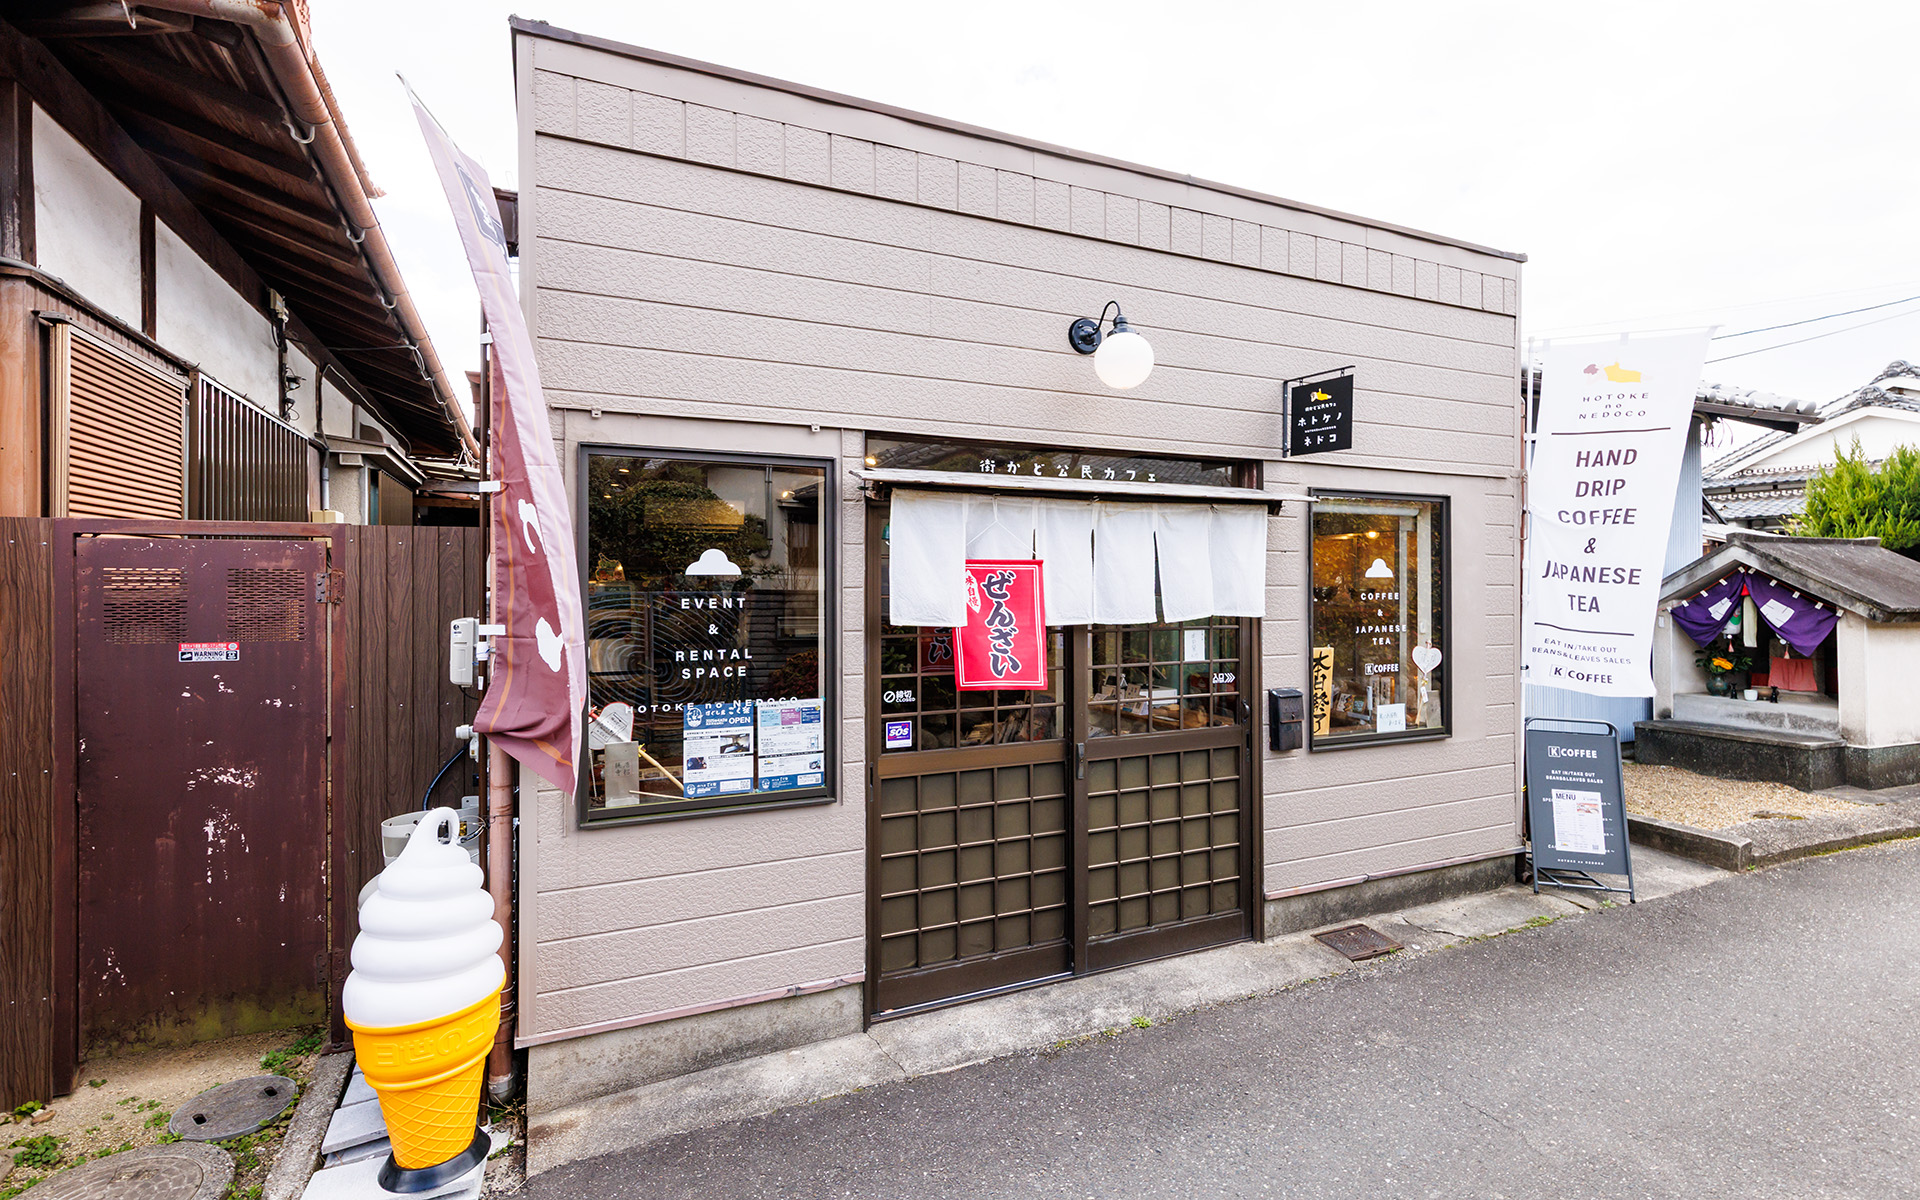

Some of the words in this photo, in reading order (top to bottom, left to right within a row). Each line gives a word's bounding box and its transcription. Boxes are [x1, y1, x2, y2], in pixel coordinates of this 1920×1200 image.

[1582, 392, 1650, 403] HOTOKE
[1298, 412, 1342, 427] ホトケノ
[1578, 410, 1647, 420] NEDOCO
[1304, 434, 1337, 447] ネドコ
[1575, 449, 1638, 468] HAND
[979, 457, 1157, 483] 街かど公民カフェ
[1575, 478, 1626, 498] DRIP
[1557, 508, 1638, 526] COFFEE
[1583, 537, 1597, 554] &
[1541, 560, 1642, 585] JAPANESE
[681, 597, 746, 609] EVENT
[1360, 592, 1399, 601] COFFEE
[1567, 594, 1601, 613] TEA
[1377, 609, 1383, 617] &
[708, 623, 719, 635] &
[981, 570, 1021, 678] ぜんざい
[1355, 624, 1407, 634] JAPANESE
[1372, 637, 1391, 646] TEA
[1544, 638, 1561, 646] EAT
[1564, 643, 1598, 652] IN/TAKE
[675, 648, 753, 662] RENTAL
[1532, 646, 1601, 663] BEANS&LEAVES
[1603, 657, 1632, 665] SALES
[681, 665, 747, 680] SPACE
[1373, 663, 1399, 673] COFFEE
[1568, 670, 1613, 684] COFFEE
[625, 702, 694, 714] HOTOKE
[704, 702, 723, 710] no
[889, 728, 909, 736] SOS
[1560, 748, 1598, 759] COFFEE
[1555, 793, 1576, 801] MENU
